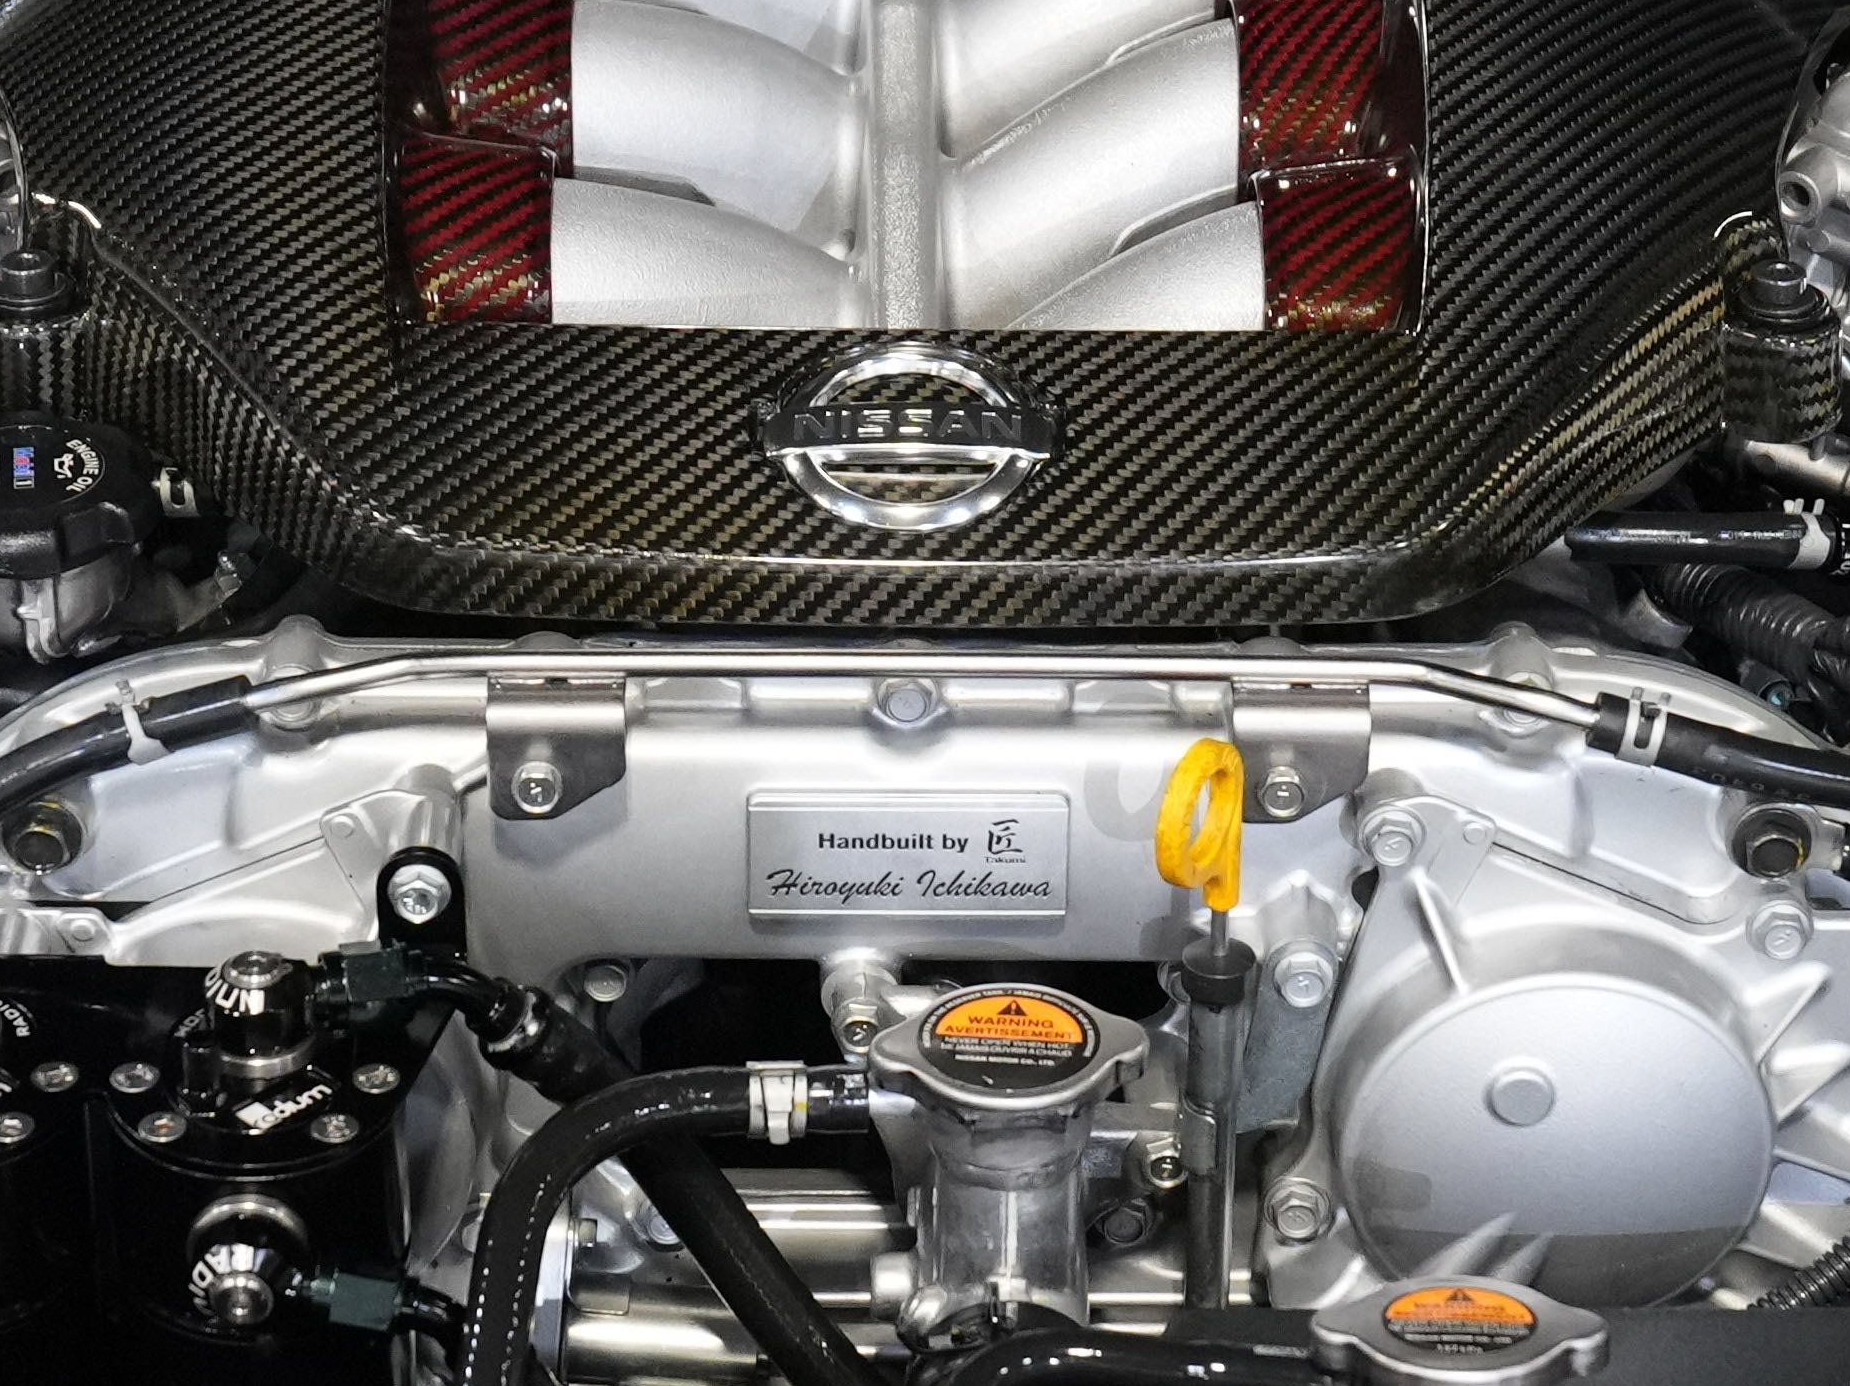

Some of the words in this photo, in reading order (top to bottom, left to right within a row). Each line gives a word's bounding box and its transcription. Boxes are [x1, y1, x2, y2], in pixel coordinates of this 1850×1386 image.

[794, 408, 1022, 441] NISSAN
[66, 438, 100, 476] ENGINE
[66, 476, 94, 494] OIL
[818, 832, 935, 851] Handbuilt
[942, 832, 969, 854] by
[986, 818, 1024, 856] 匠
[766, 868, 905, 905] Hiroyuki
[916, 868, 1052, 899] Ichikawa
[944, 1024, 1073, 1040] AVERTISSEMENT
[967, 1015, 1054, 1029] WARNING
[944, 1036, 979, 1044] NEVER
[981, 1037, 1012, 1046] OPEN
[1013, 1039, 1046, 1048] WHEN
